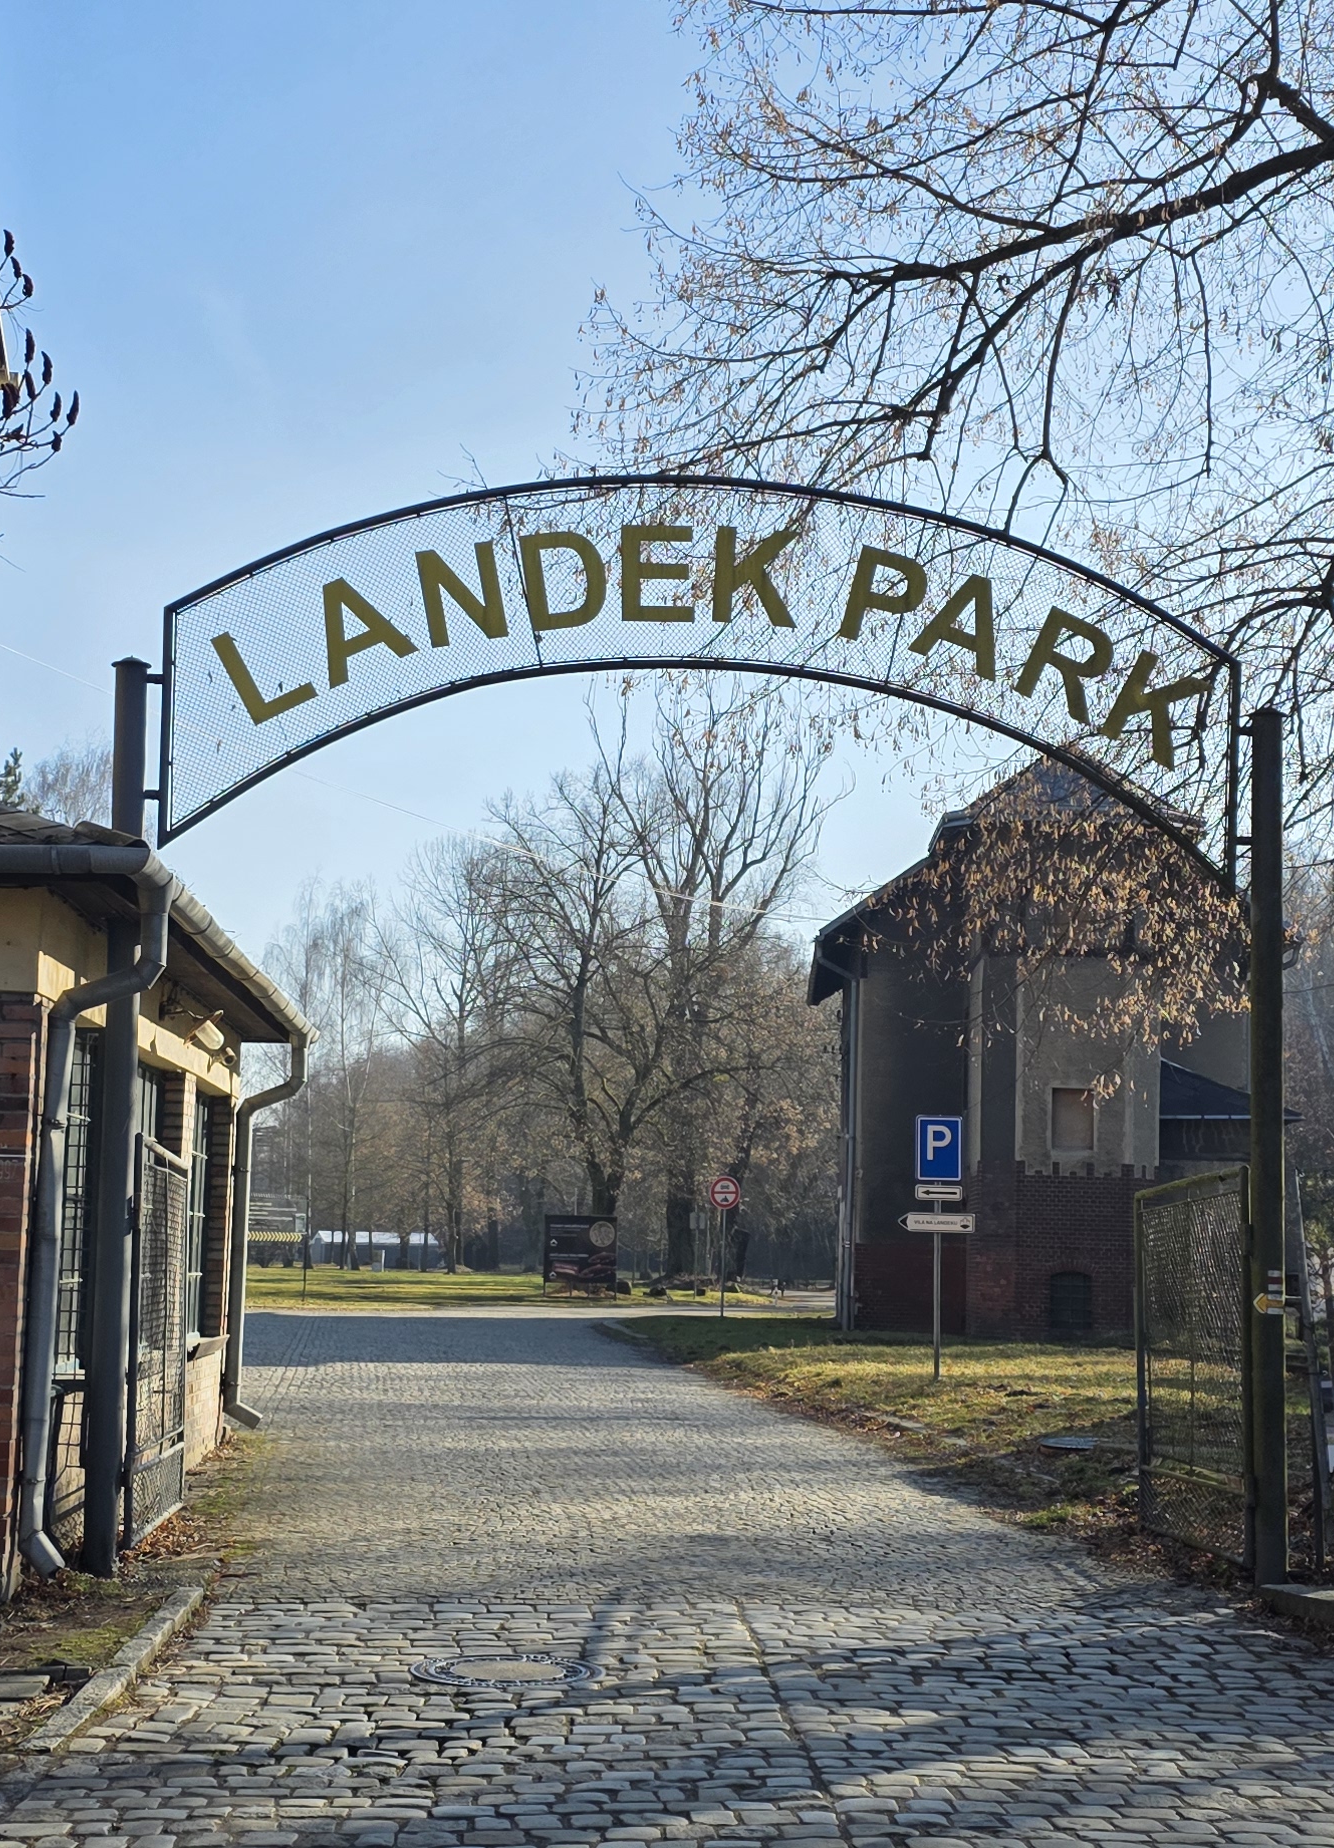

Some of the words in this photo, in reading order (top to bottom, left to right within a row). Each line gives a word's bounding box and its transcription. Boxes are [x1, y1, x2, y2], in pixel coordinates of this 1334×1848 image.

[211, 525, 801, 724] LANDEK
[839, 545, 1213, 771] PARK
[927, 1125, 952, 1160] P
